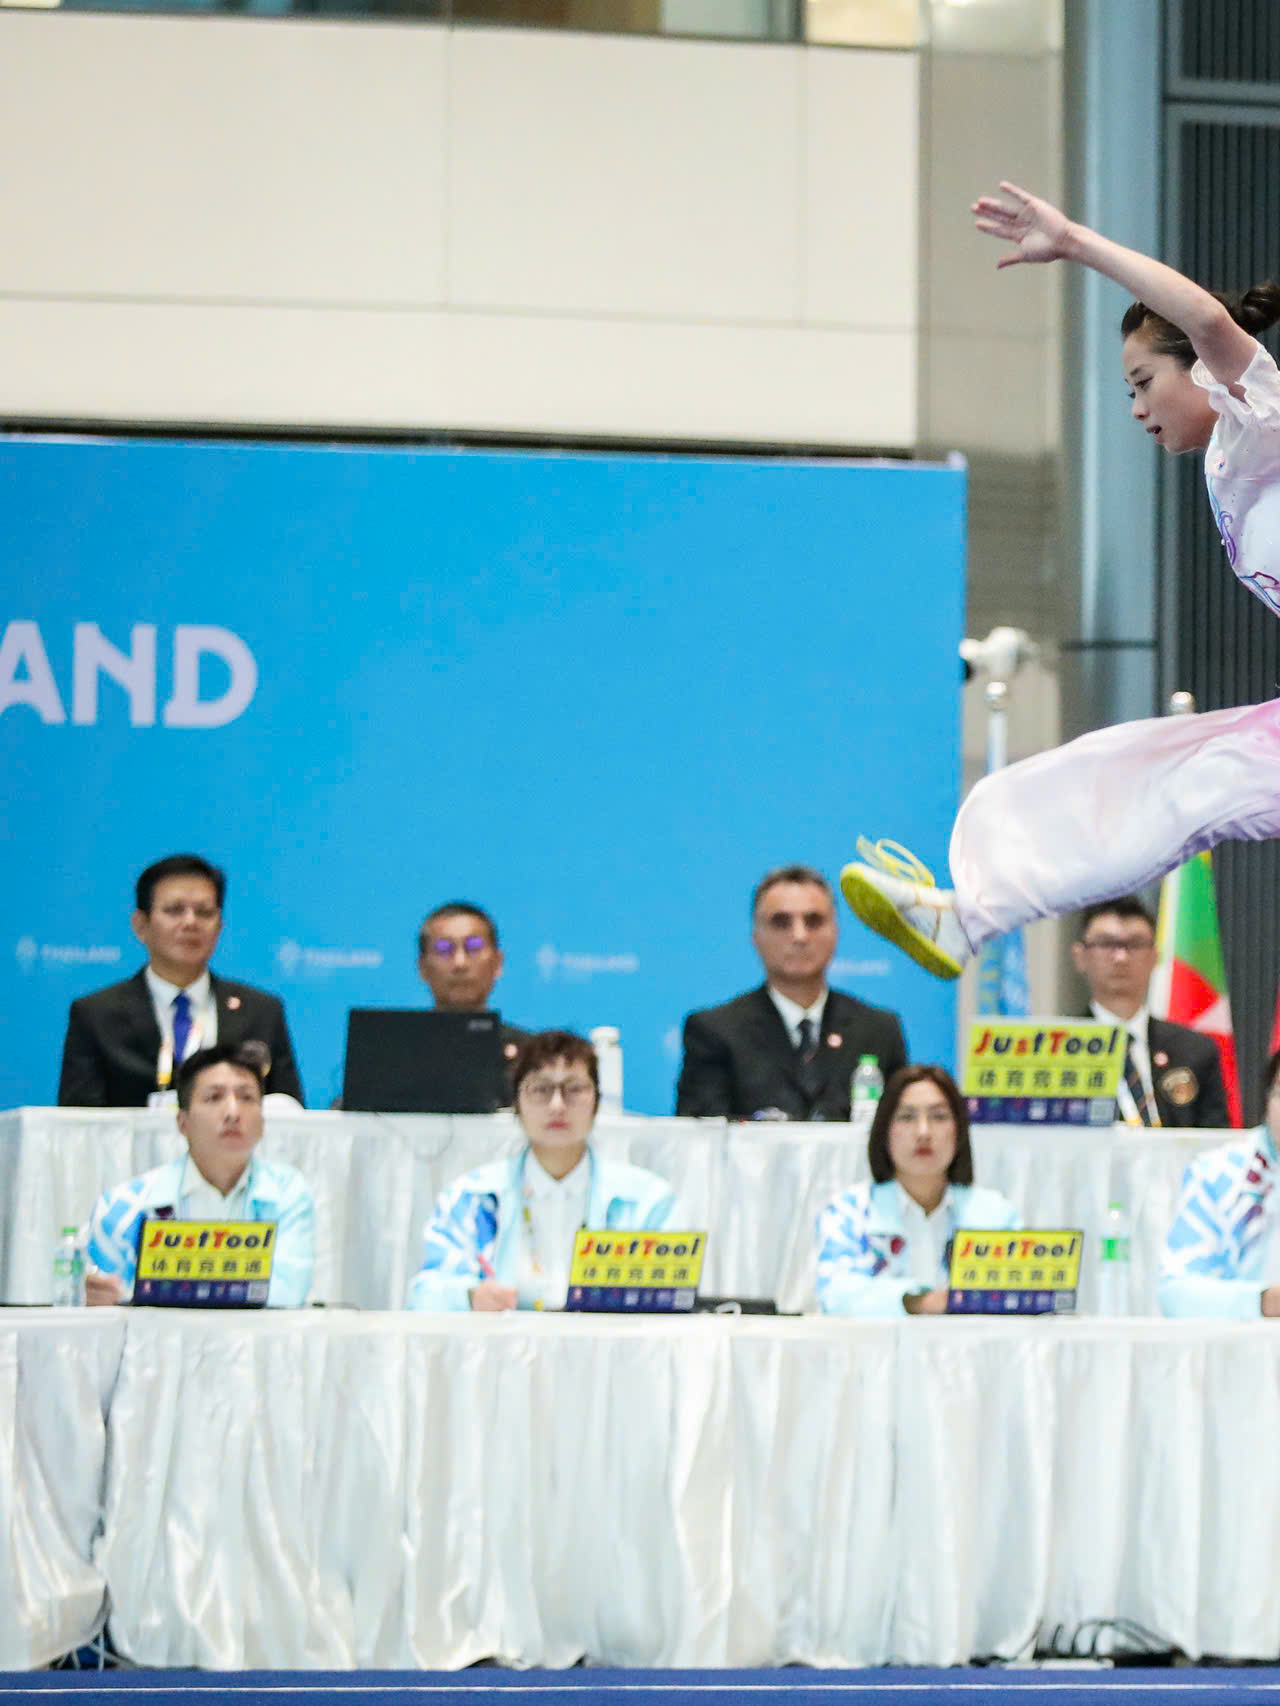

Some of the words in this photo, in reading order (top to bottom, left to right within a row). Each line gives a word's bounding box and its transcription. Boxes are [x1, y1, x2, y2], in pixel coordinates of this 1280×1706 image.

[0, 620, 258, 728] AND
[974, 1027, 1118, 1055] JustTool
[148, 1228, 273, 1249] JustTool
[580, 1237, 699, 1257] JustTool
[960, 1237, 1076, 1258] JustTool
